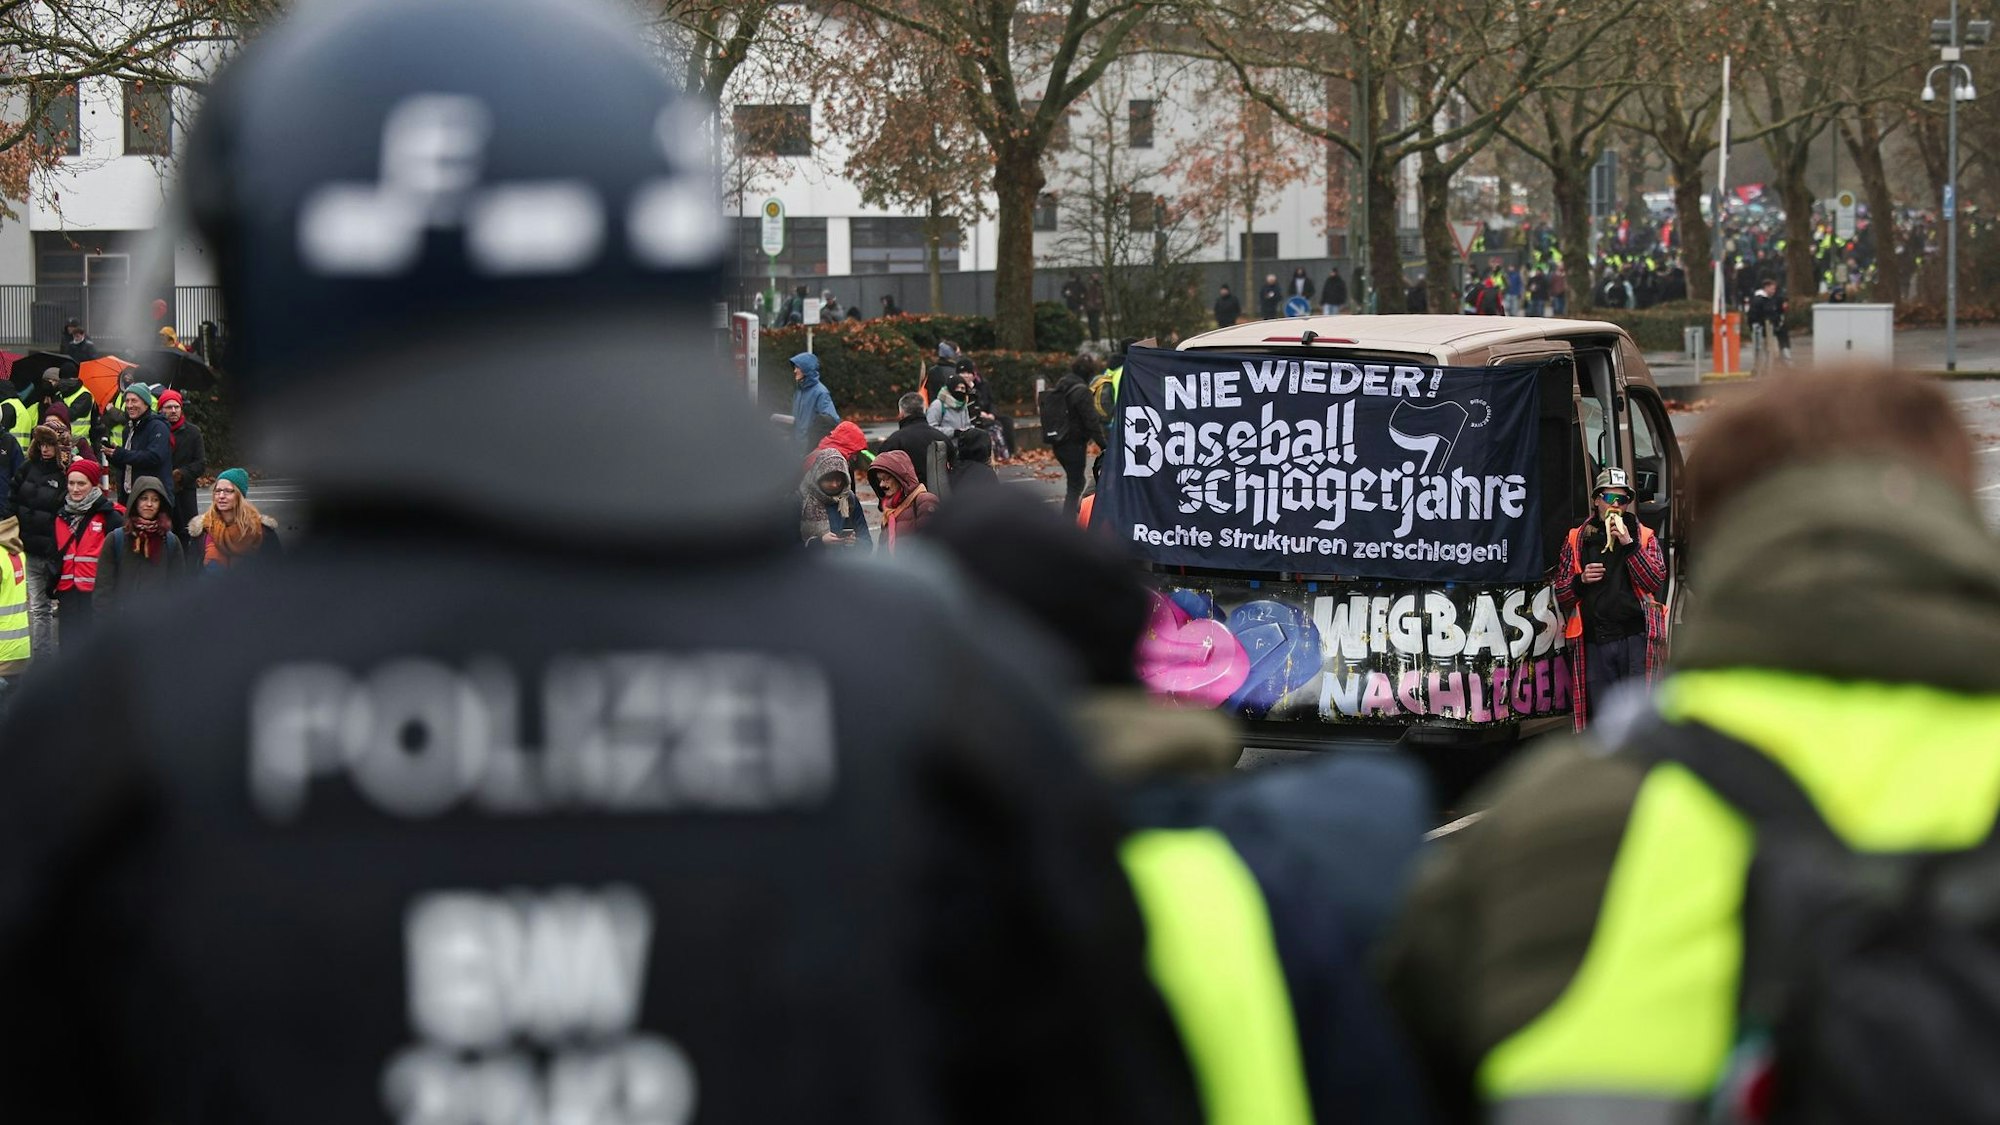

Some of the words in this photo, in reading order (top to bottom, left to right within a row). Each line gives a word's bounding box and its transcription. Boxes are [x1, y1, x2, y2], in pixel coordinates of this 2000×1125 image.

[1165, 371, 1242, 411] NIE
[1242, 360, 1444, 399] WIEDER!
[1123, 399, 1358, 478] Baseball
[1133, 523, 1213, 547] Rechte
[1218, 527, 1348, 555] Strukturen
[1353, 538, 1508, 565] zerschlagen!
